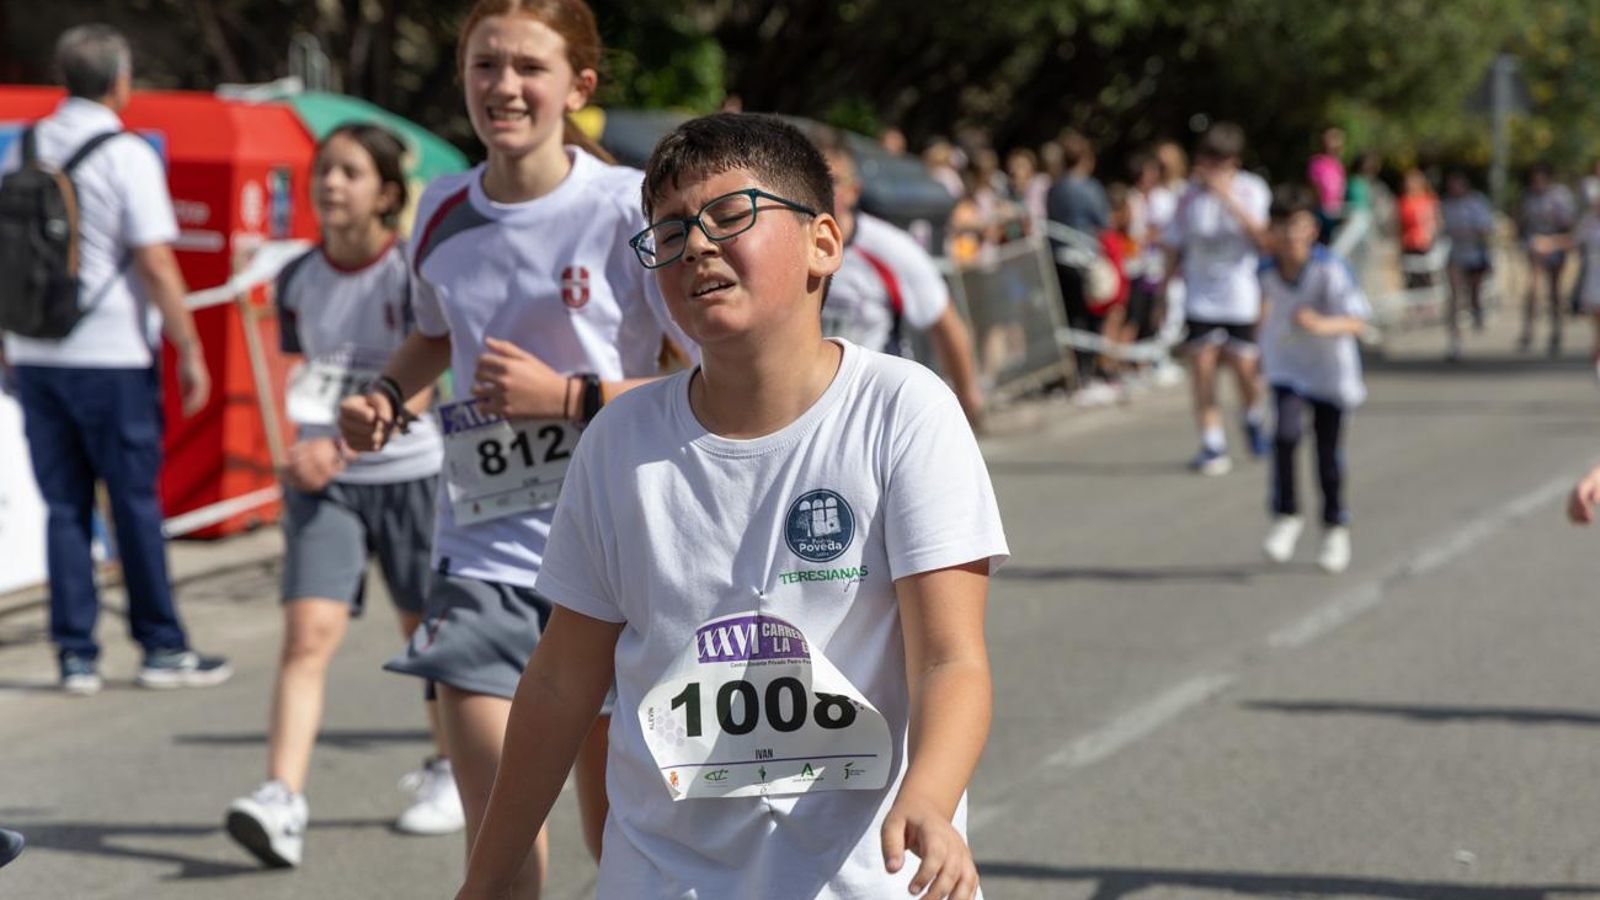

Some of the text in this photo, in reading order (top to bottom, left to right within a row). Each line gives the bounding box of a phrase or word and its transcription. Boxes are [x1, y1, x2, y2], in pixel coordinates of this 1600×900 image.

[477, 424, 571, 476] 812
[799, 541, 843, 552] Poveda
[779, 565, 869, 585] TERESIANAS
[773, 637, 791, 652] LA
[671, 677, 857, 738] 1008
